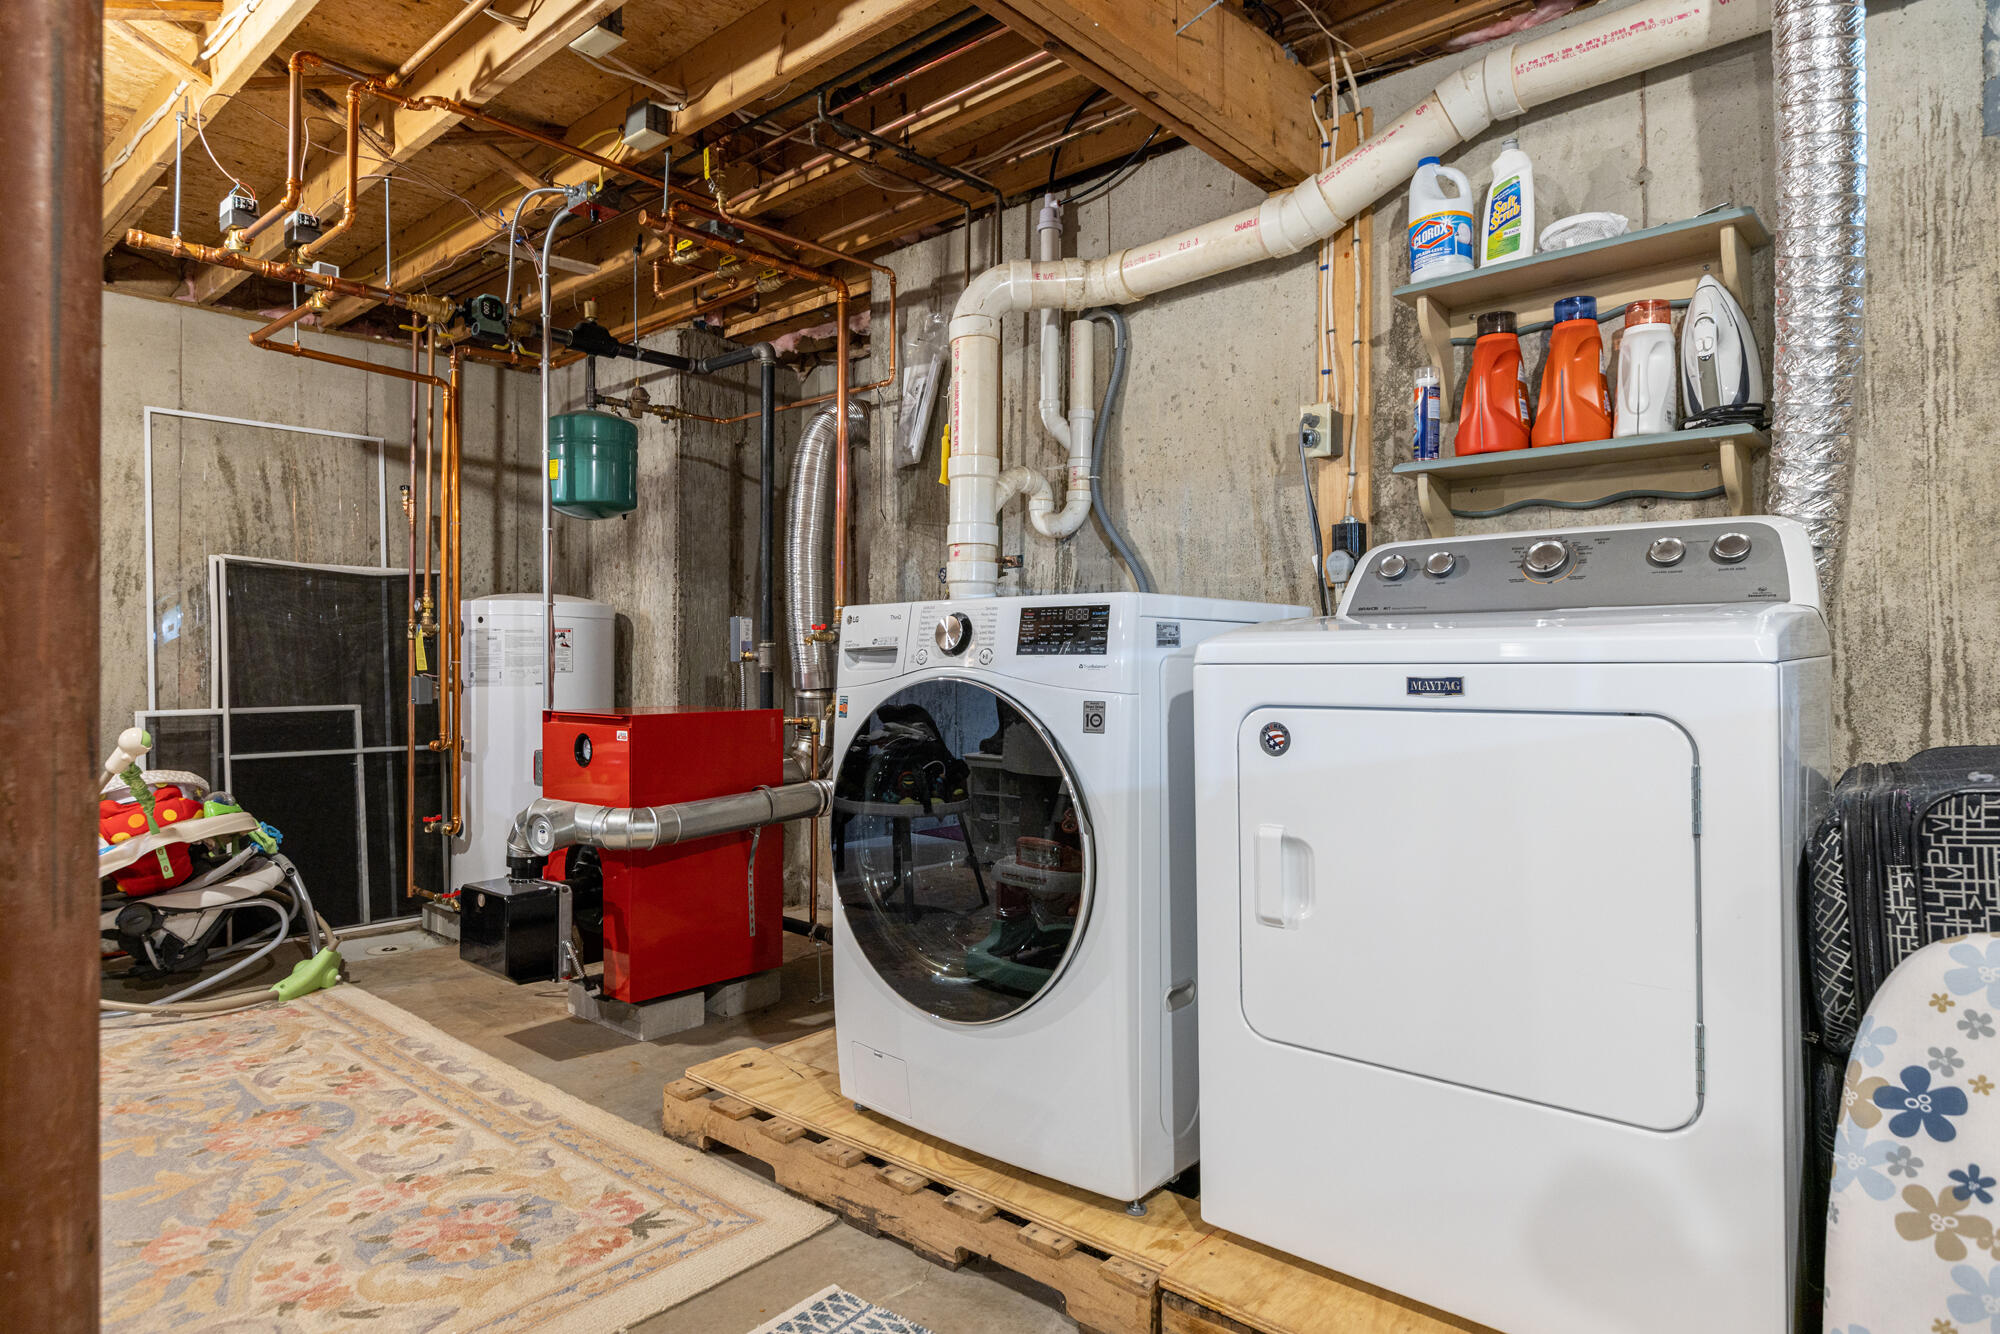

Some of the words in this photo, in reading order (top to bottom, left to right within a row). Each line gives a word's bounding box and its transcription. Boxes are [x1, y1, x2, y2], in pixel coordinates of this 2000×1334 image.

[1494, 195, 1517, 214] Soft
[1490, 203, 1520, 230] Scrub
[1413, 222, 1449, 250] CLOROX
[1411, 680, 1460, 691] MAYTAG
[1086, 713, 1103, 728] 10
